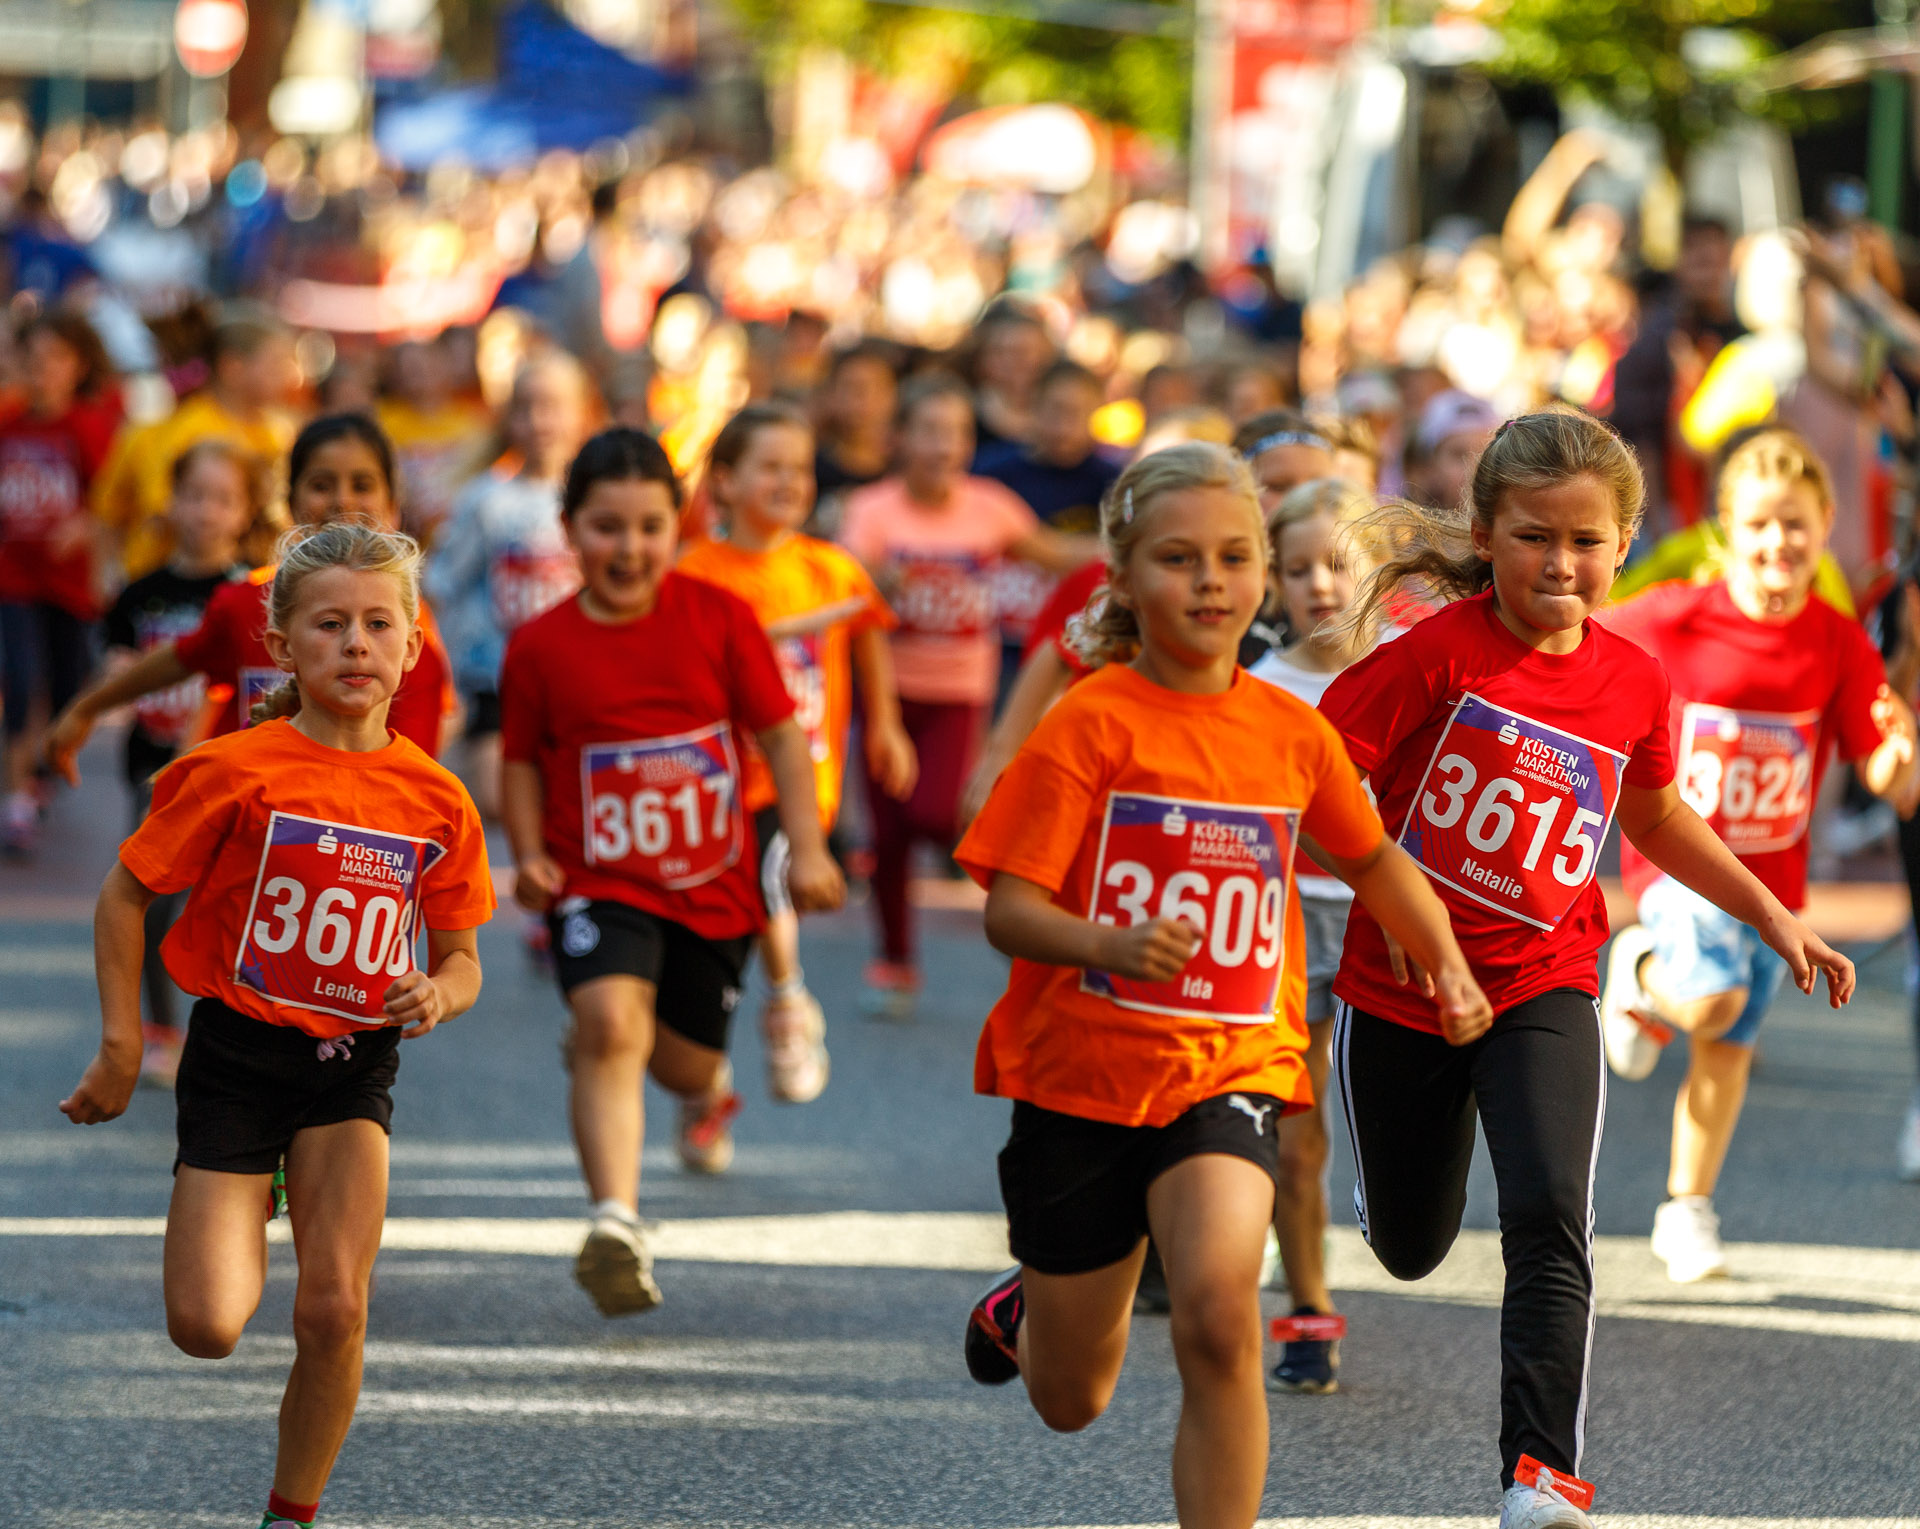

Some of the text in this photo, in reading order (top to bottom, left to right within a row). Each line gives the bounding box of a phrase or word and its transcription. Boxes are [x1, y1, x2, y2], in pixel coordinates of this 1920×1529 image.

[1521, 737, 1579, 769] KÜSTEN
[1512, 766, 1572, 795] zum Weltkindertag
[1515, 752, 1590, 790] MARATHON
[592, 773, 734, 862] 3617
[1193, 819, 1259, 843] KÜSTEN
[1421, 753, 1604, 887] 3615
[343, 843, 404, 867] KÜSTEN
[1190, 839, 1272, 861] MARATHON
[340, 859, 414, 884] MARATHON
[1460, 857, 1523, 899] Natalie
[253, 876, 413, 977] 3608
[1098, 860, 1283, 969] 3609
[313, 976, 367, 1005] Lenke
[1182, 976, 1213, 1000] Ida
